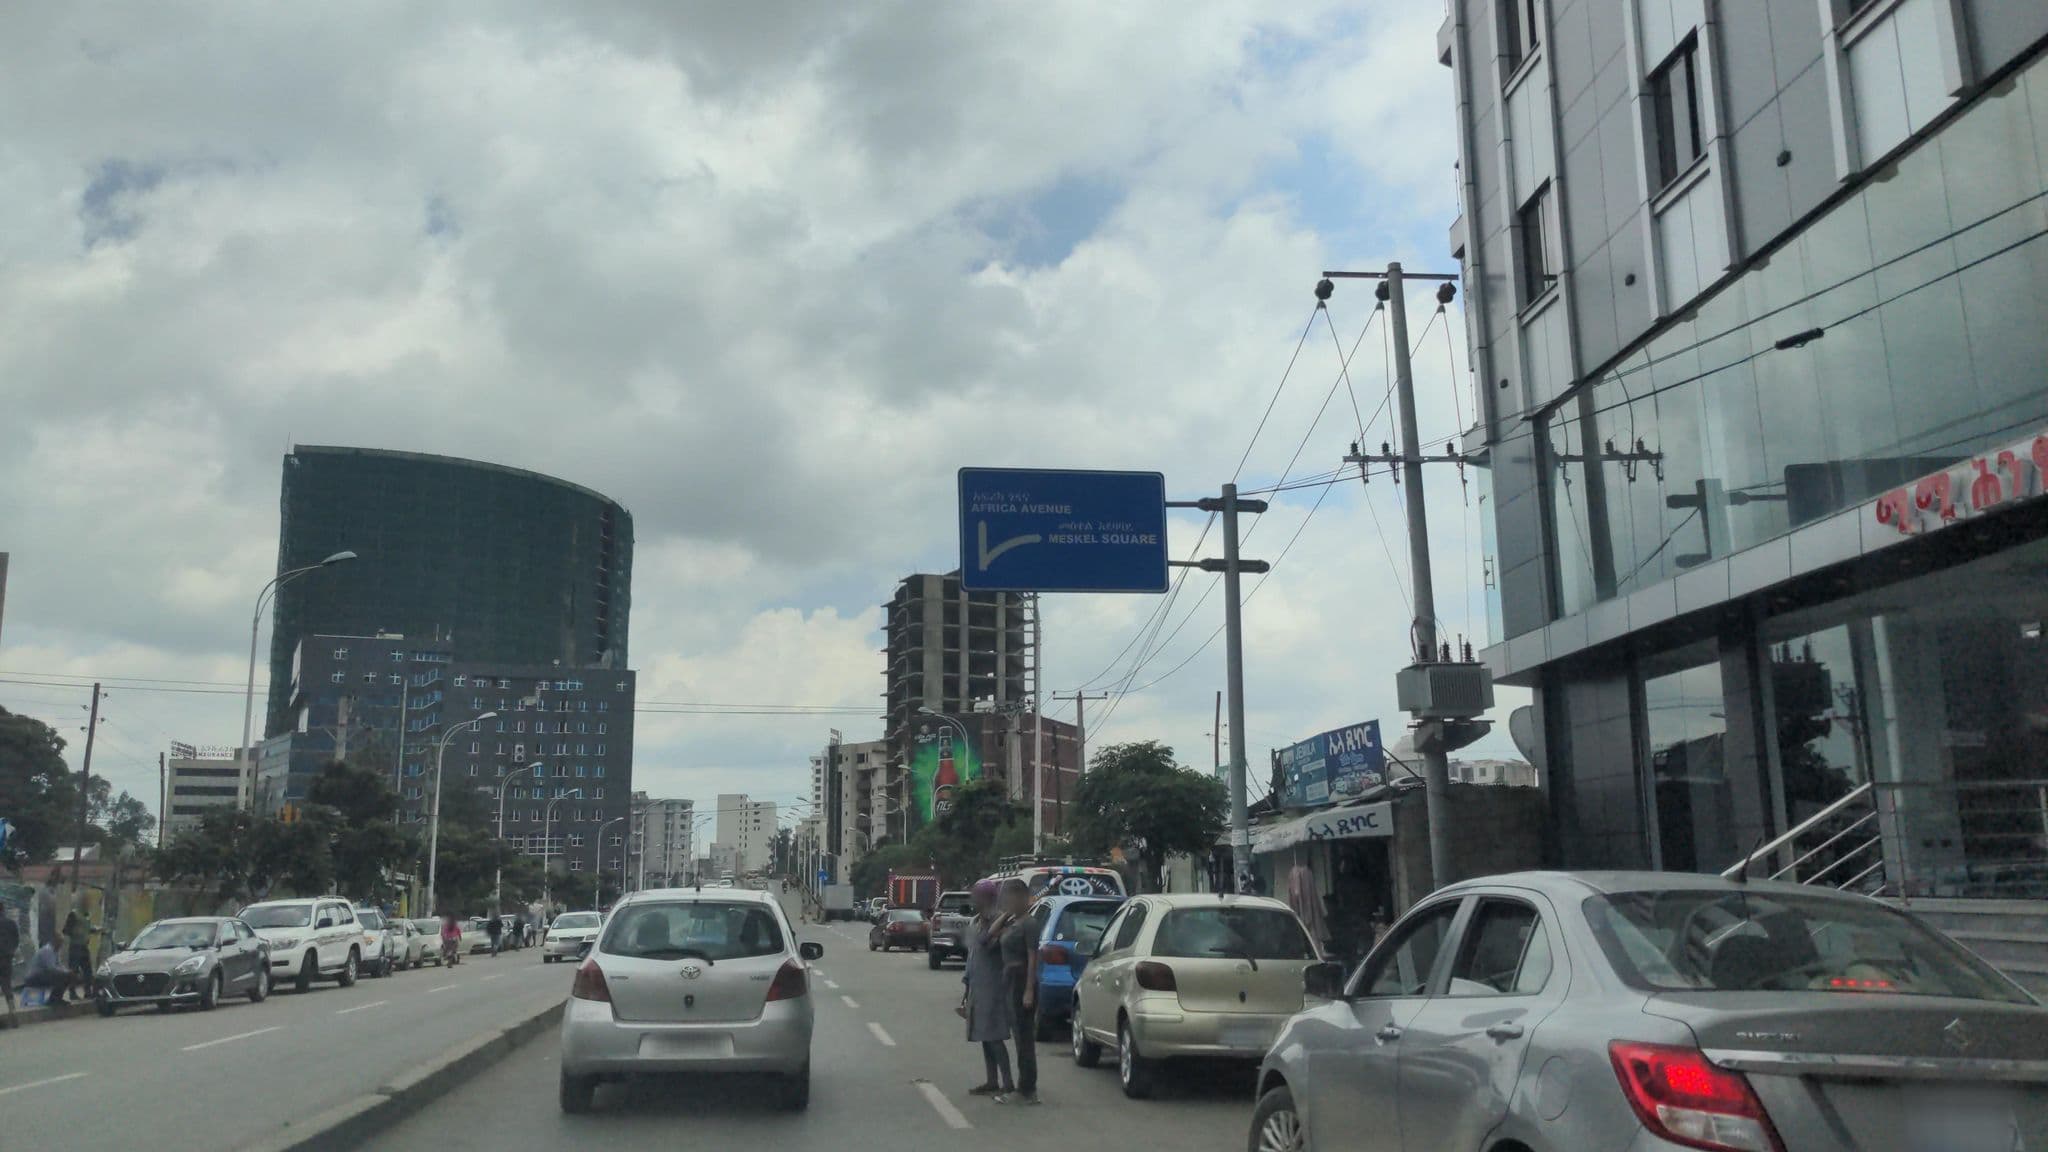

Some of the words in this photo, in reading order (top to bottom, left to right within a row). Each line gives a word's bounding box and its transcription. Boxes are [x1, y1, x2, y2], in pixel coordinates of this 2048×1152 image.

[971, 503, 1017, 513] AFRICA
[1021, 504, 1072, 514] AVENUE
[1048, 534, 1098, 544] MESKEL
[1102, 534, 1158, 545] SQUARE
